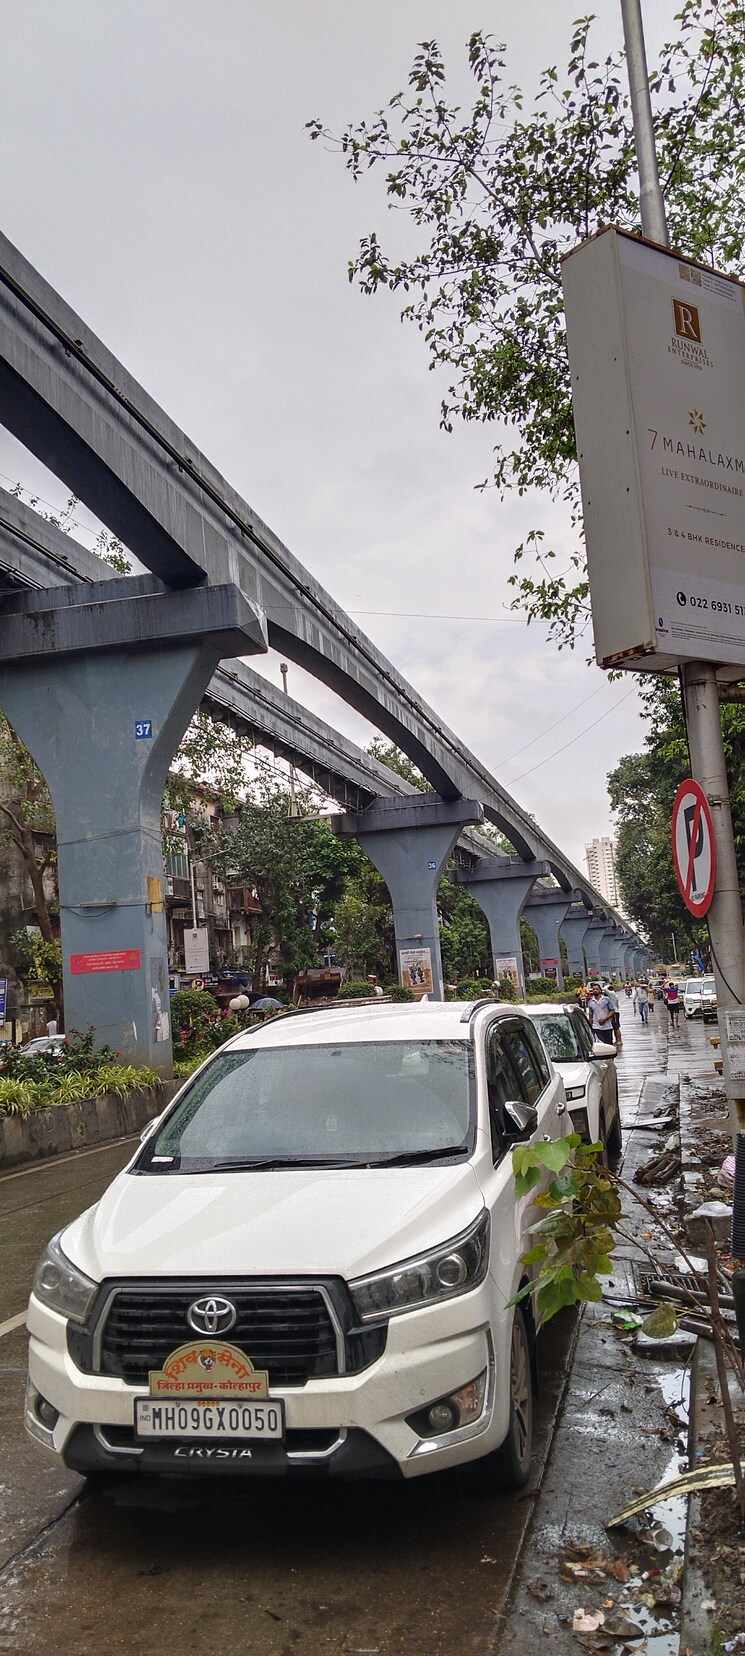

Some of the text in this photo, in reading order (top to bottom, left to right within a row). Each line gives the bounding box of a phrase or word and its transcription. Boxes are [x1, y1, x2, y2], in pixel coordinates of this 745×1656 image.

[677, 304, 698, 338] R
[667, 345, 714, 368] ENTERPRISES
[671, 337, 710, 360] RUNWAL
[647, 428, 745, 473] 7 MAHALAXM
[661, 467, 743, 496] LIVE EXTRAORDINAIRE
[667, 527, 745, 553] 3 & 4 BHK RESIDENCE
[690, 596, 709, 609] 022
[711, 600, 732, 614] 6931
[136, 723, 151, 736] 37
[165, 1349, 251, 1381] शिव सेना
[157, 1380, 185, 1392] जिल्हा
[152, 1407, 278, 1432] MH09GX0050
[174, 1447, 253, 1459] CRYSTA
